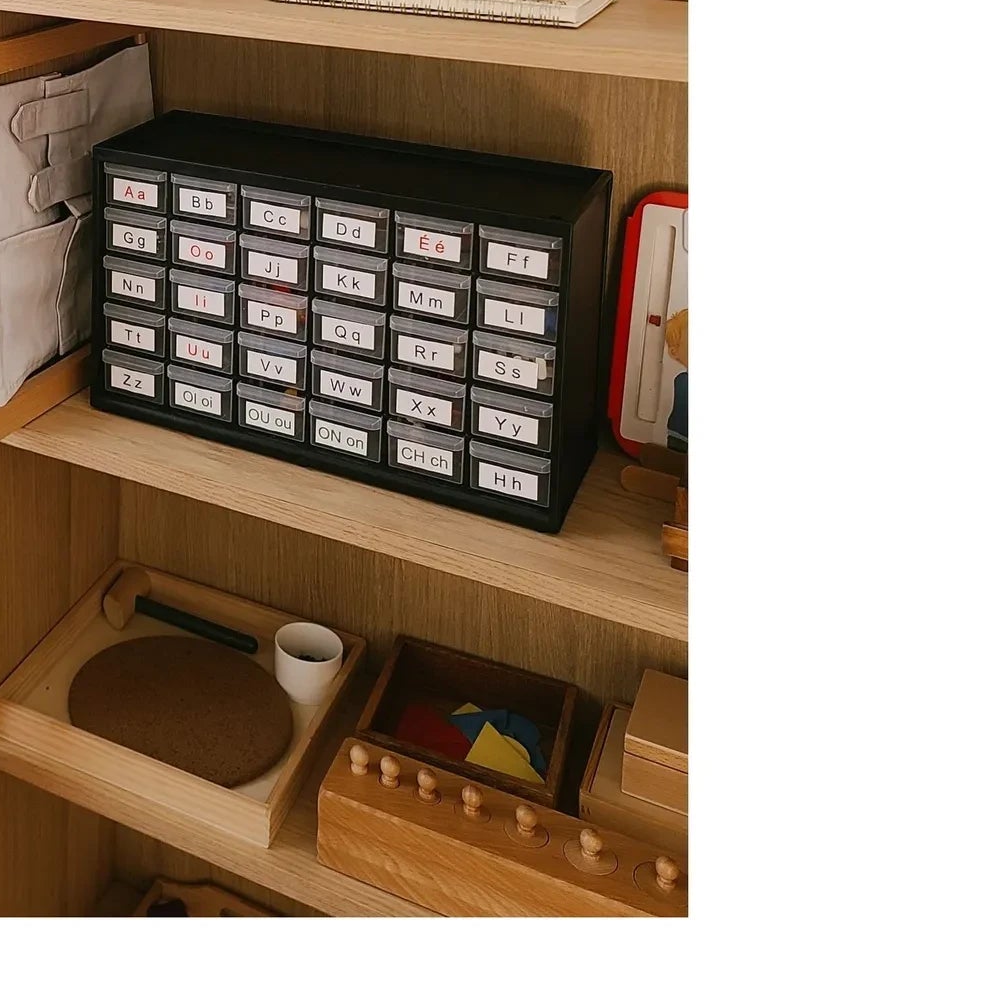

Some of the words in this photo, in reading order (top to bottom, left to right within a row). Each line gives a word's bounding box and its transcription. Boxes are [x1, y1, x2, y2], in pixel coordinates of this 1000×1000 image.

[182, 390, 197, 405] OI
[201, 396, 213, 409] oi
[248, 408, 270, 425] OU
[274, 417, 292, 430] ou
[318, 426, 342, 444] ON
[346, 436, 364, 450] on
[401, 446, 425, 464] CH
[430, 455, 449, 470] ch
